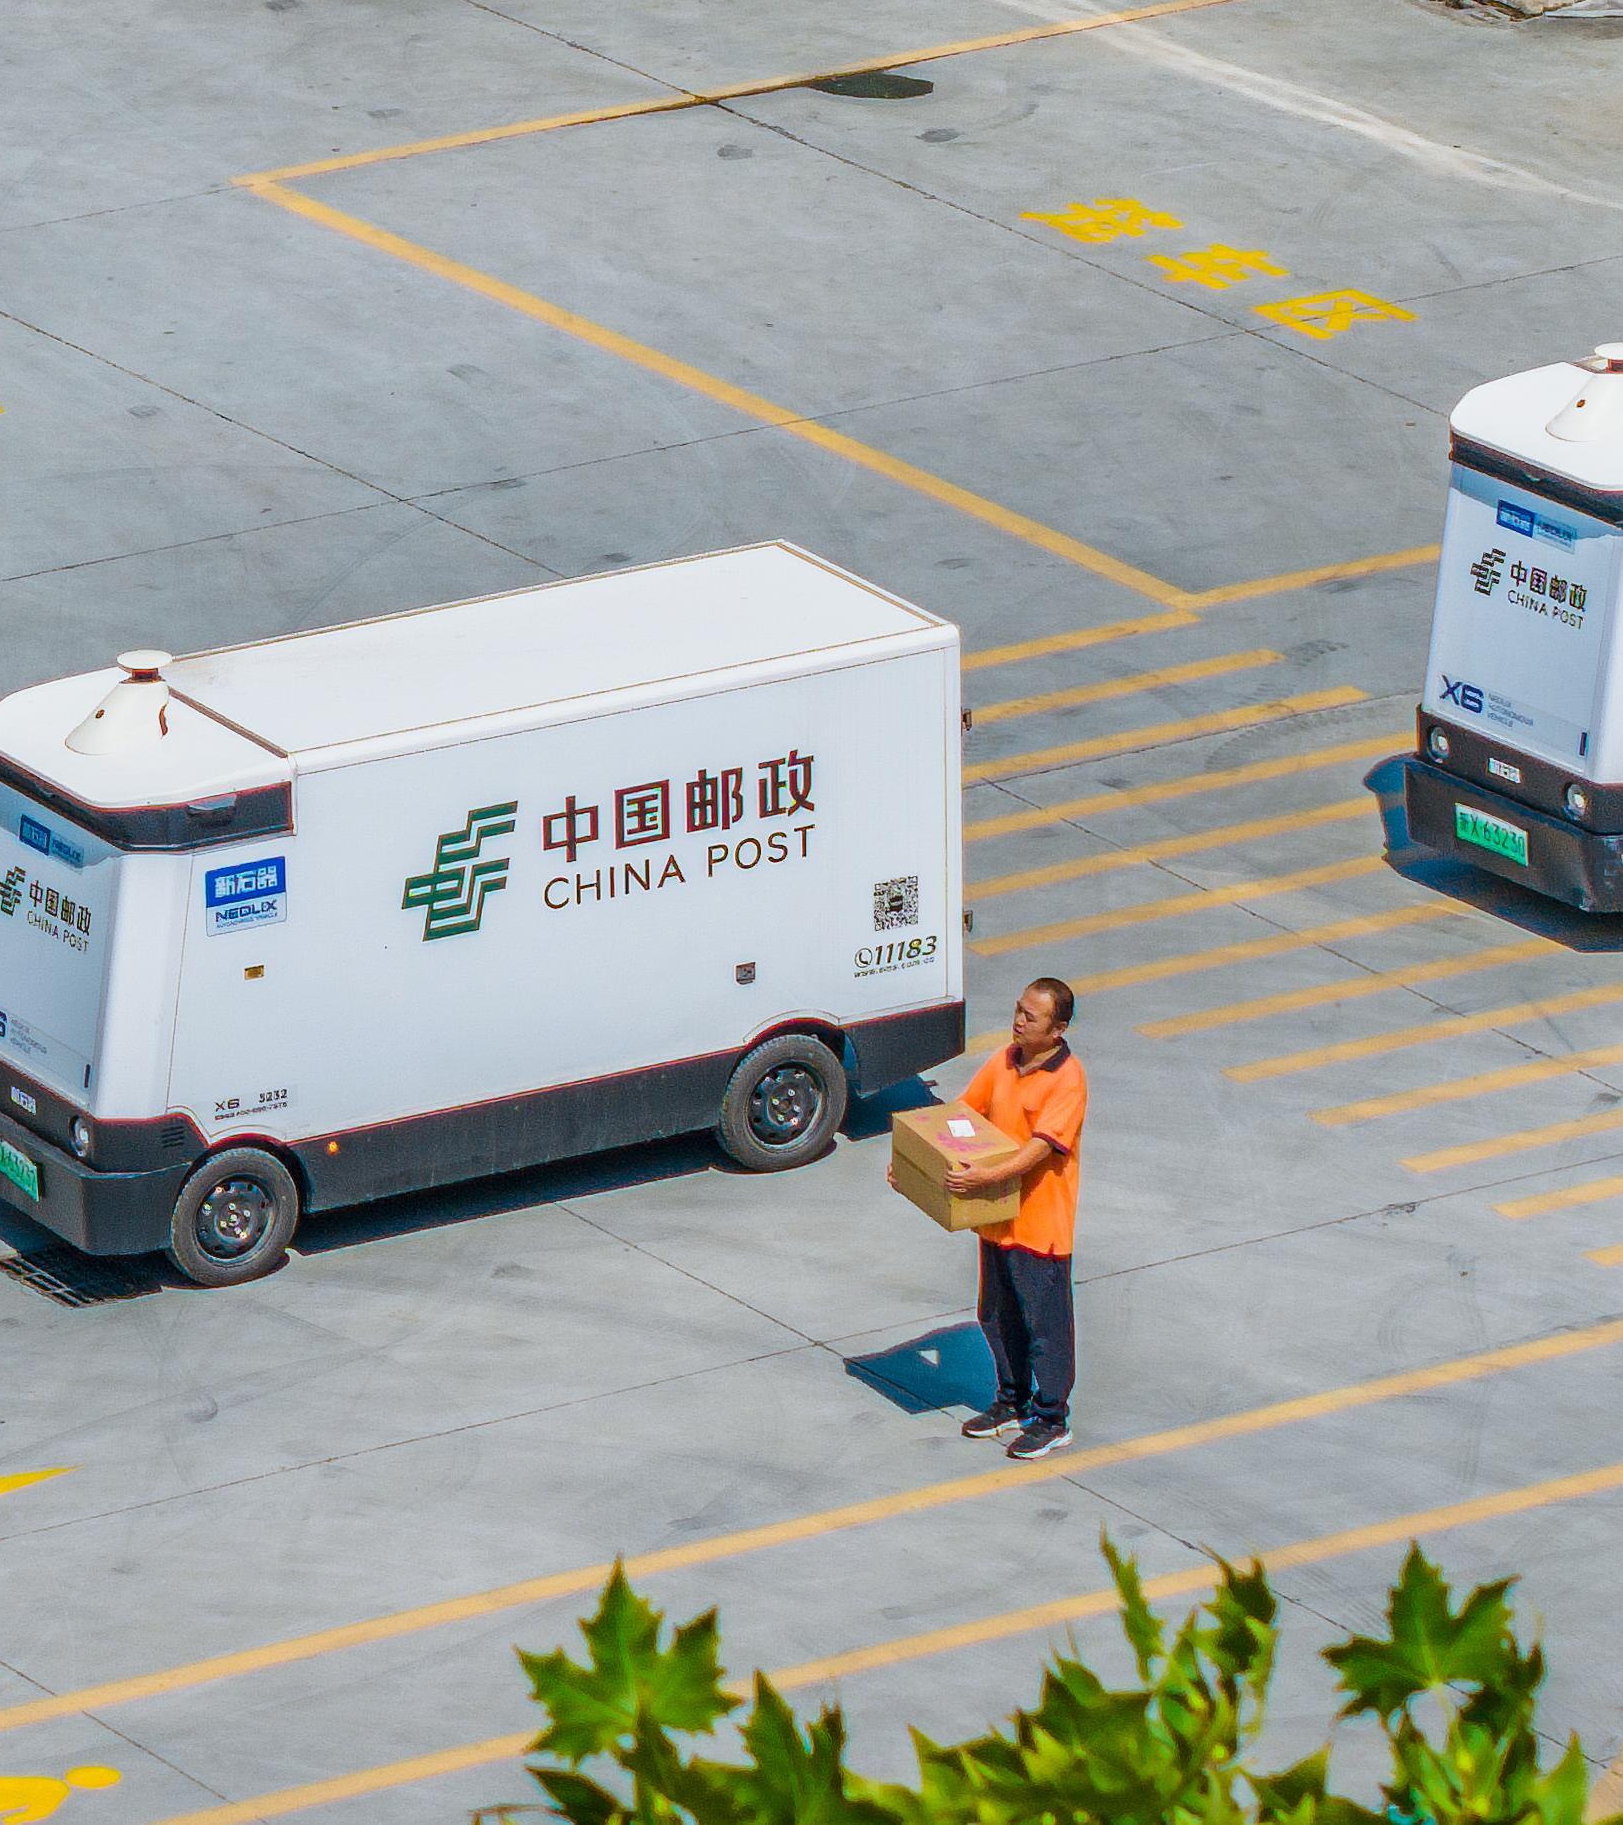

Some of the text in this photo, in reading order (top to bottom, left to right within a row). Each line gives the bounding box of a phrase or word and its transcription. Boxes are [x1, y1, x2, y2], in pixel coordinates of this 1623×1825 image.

[1510, 560, 1588, 612] 中国邮政
[1507, 589, 1585, 630] CHINA POST
[1439, 674, 1484, 715] X6
[542, 749, 815, 863] 中国邮政
[215, 865, 278, 898] 新石器
[544, 824, 815, 910] CHINA POST
[29, 879, 91, 936] 中国邮政
[27, 909, 90, 953] CHINA POST
[875, 935, 937, 965] 11183
